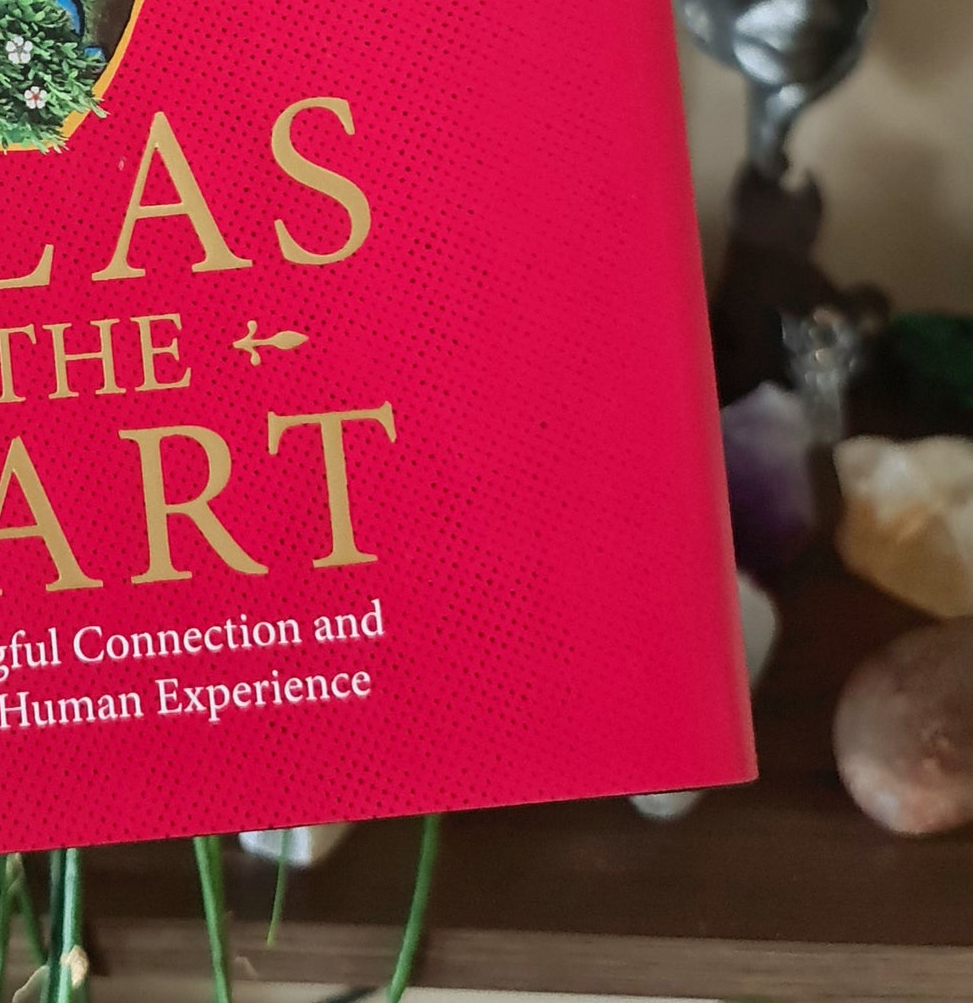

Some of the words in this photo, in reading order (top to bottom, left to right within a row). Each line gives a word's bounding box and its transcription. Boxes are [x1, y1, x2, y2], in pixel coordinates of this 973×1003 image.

[72, 614, 303, 664] Connection
[314, 599, 385, 640] and
[156, 669, 372, 723] Experience
